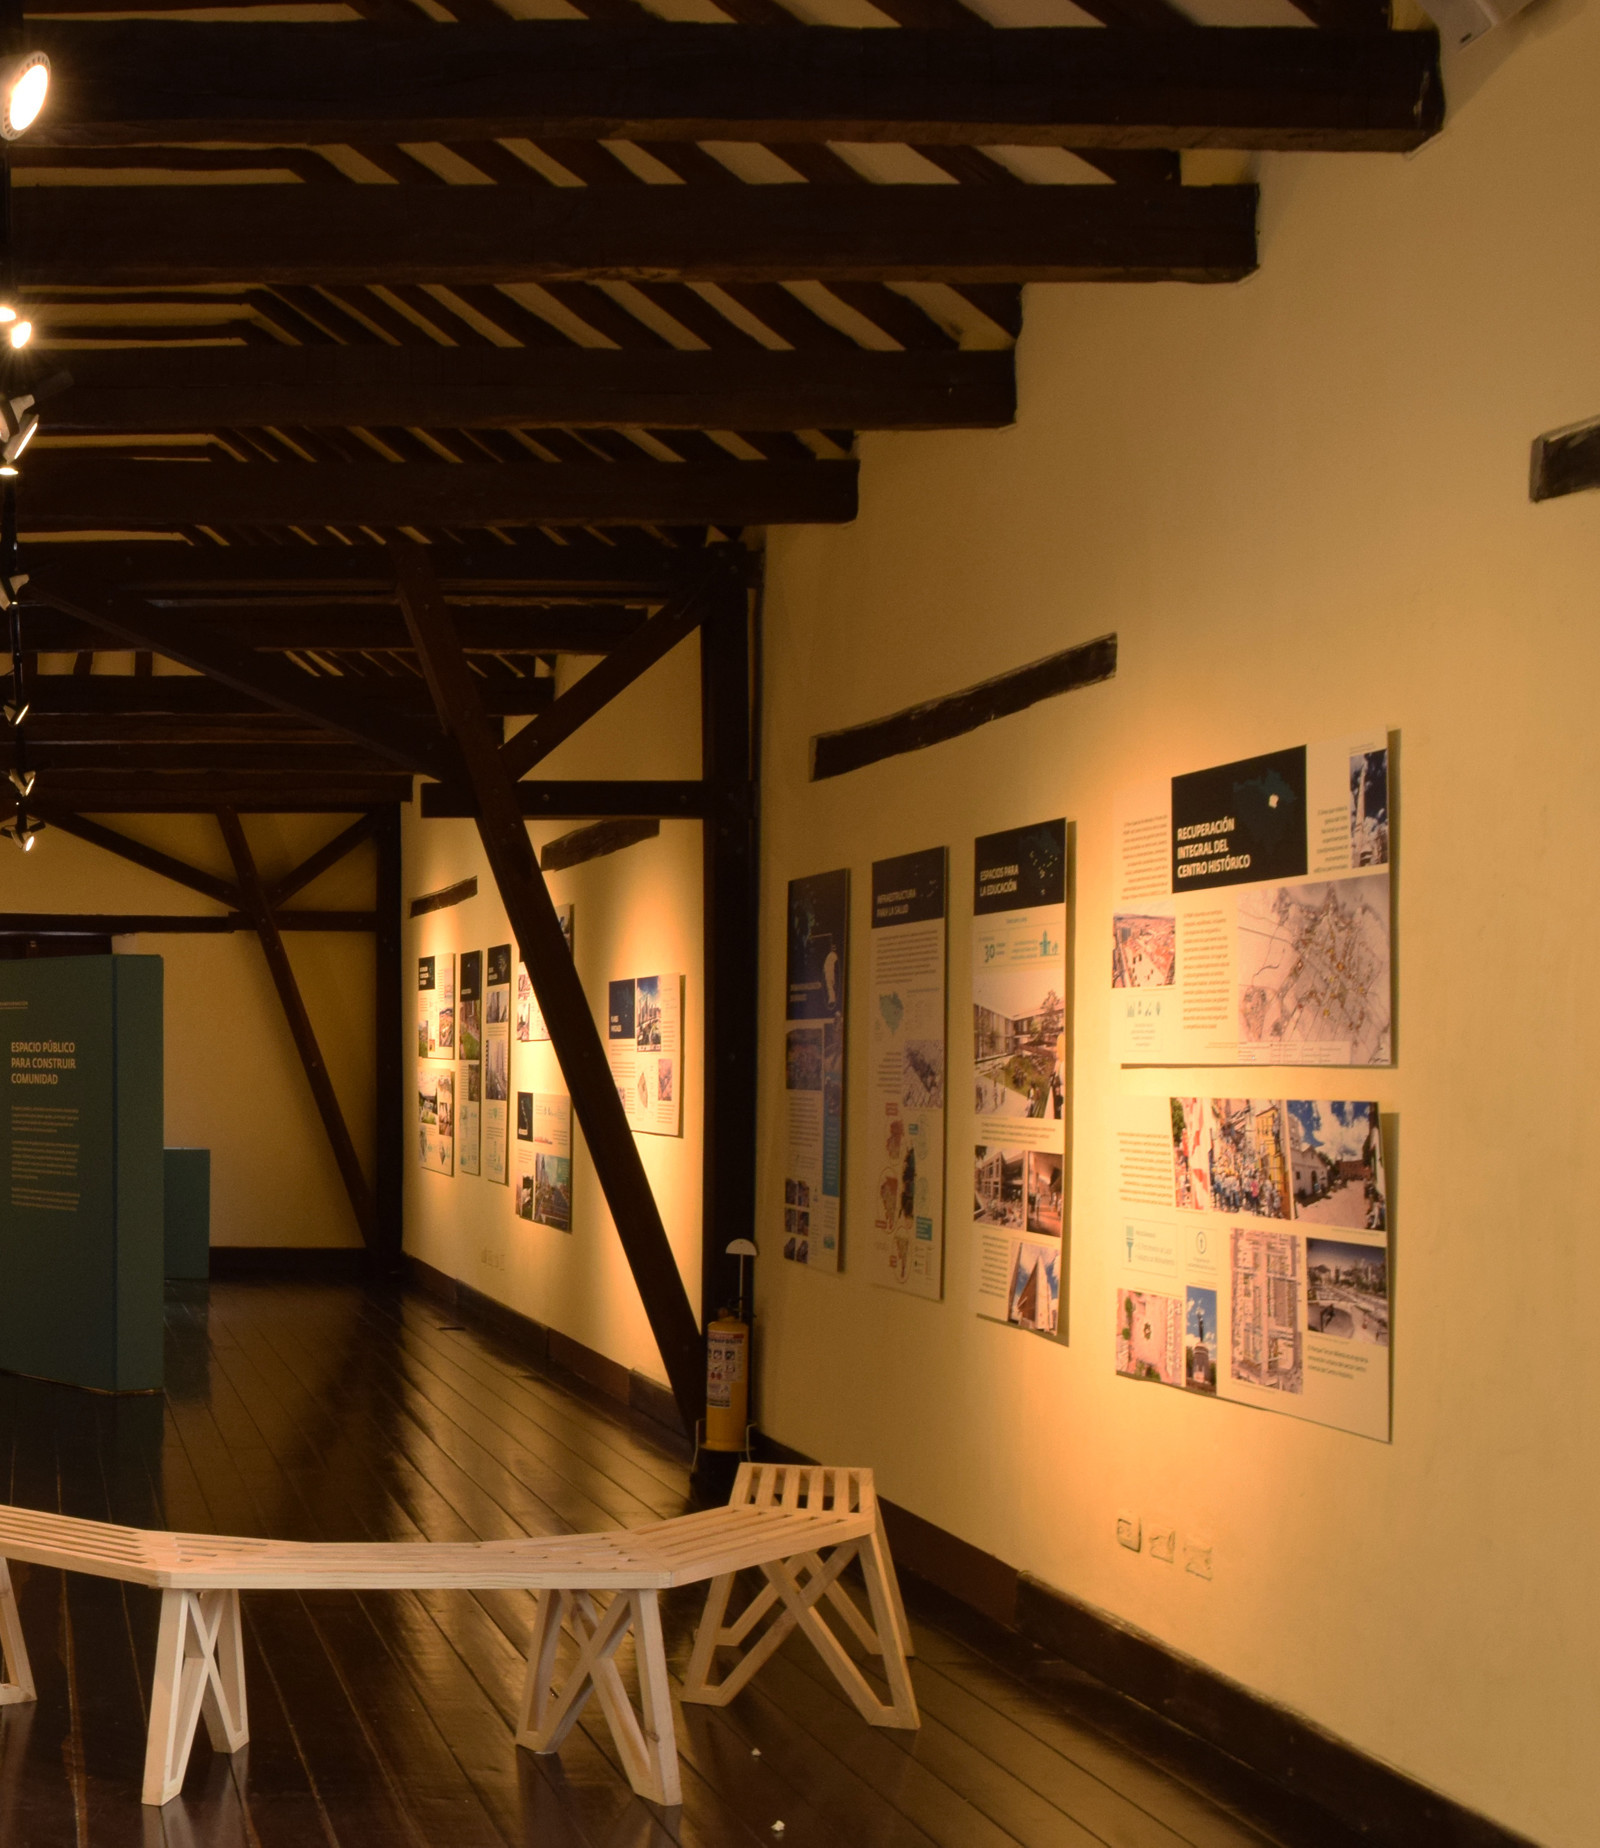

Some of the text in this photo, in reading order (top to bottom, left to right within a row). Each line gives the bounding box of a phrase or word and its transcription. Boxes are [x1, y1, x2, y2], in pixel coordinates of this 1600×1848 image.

[1177, 816, 1235, 841] RECUPERACIÓN
[1177, 838, 1229, 860] INTEGRAL DEL
[1177, 854, 1251, 878] CENTRO HISTÓRICO
[11, 1039, 76, 1053] ESPACIO PÚBLICO
[11, 1057, 76, 1069] PARA CONSTRUIR
[11, 1073, 59, 1085] COMUNIDAD
